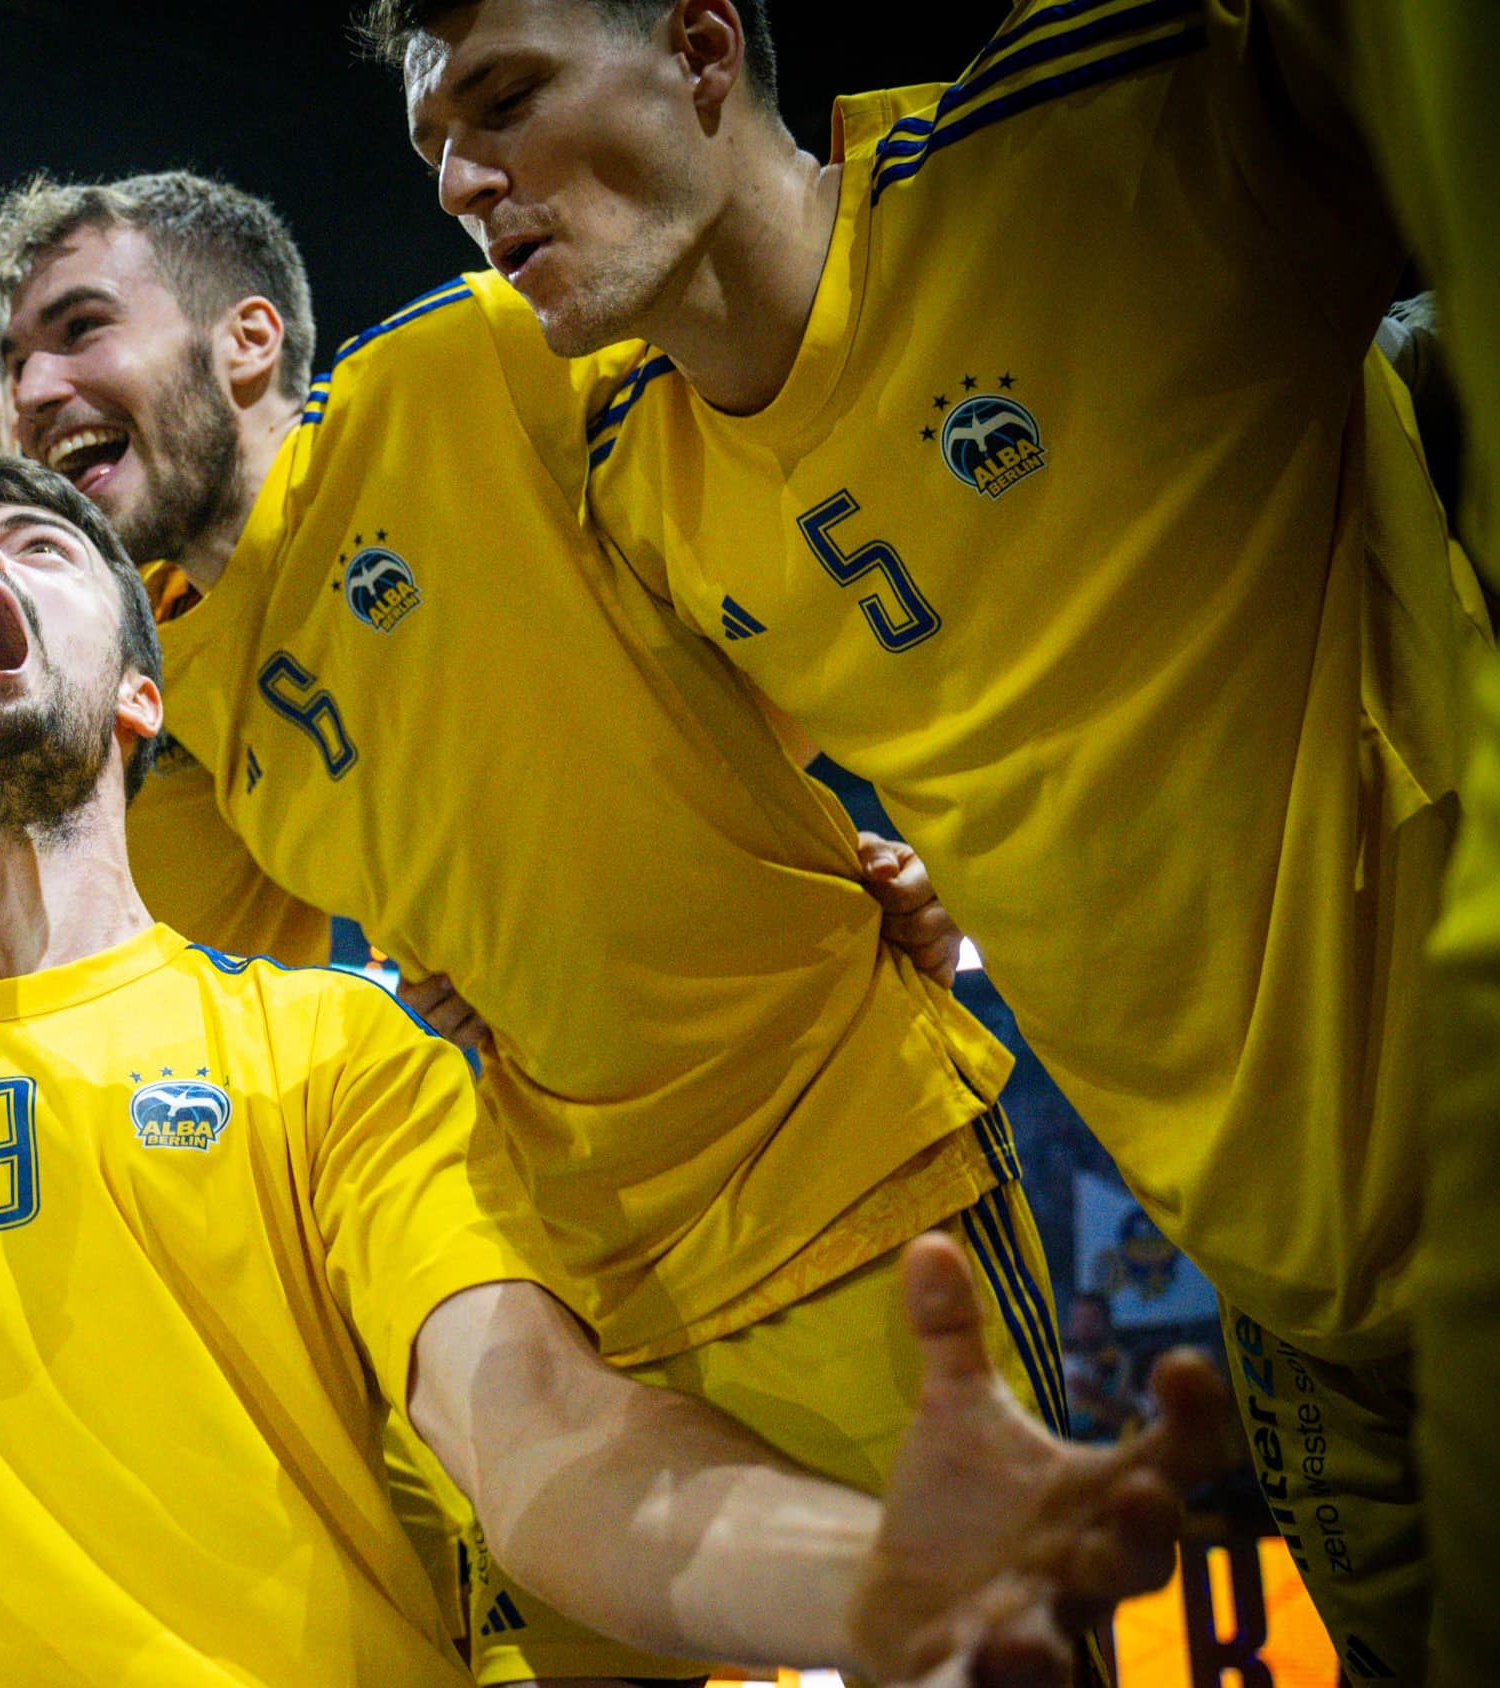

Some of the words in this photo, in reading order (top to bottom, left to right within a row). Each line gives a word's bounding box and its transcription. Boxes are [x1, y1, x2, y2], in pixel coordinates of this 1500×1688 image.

[974, 439, 1040, 491] ALBA
[988, 456, 1041, 495] BERLIN
[796, 487, 942, 653] 5
[369, 581, 414, 627] ALBA
[257, 650, 358, 781] 6
[142, 1120, 213, 1138] ALBA
[147, 1134, 206, 1148] BERLIN
[1297, 1402, 1332, 1496] waste
[1315, 1503, 1350, 1574] zero
